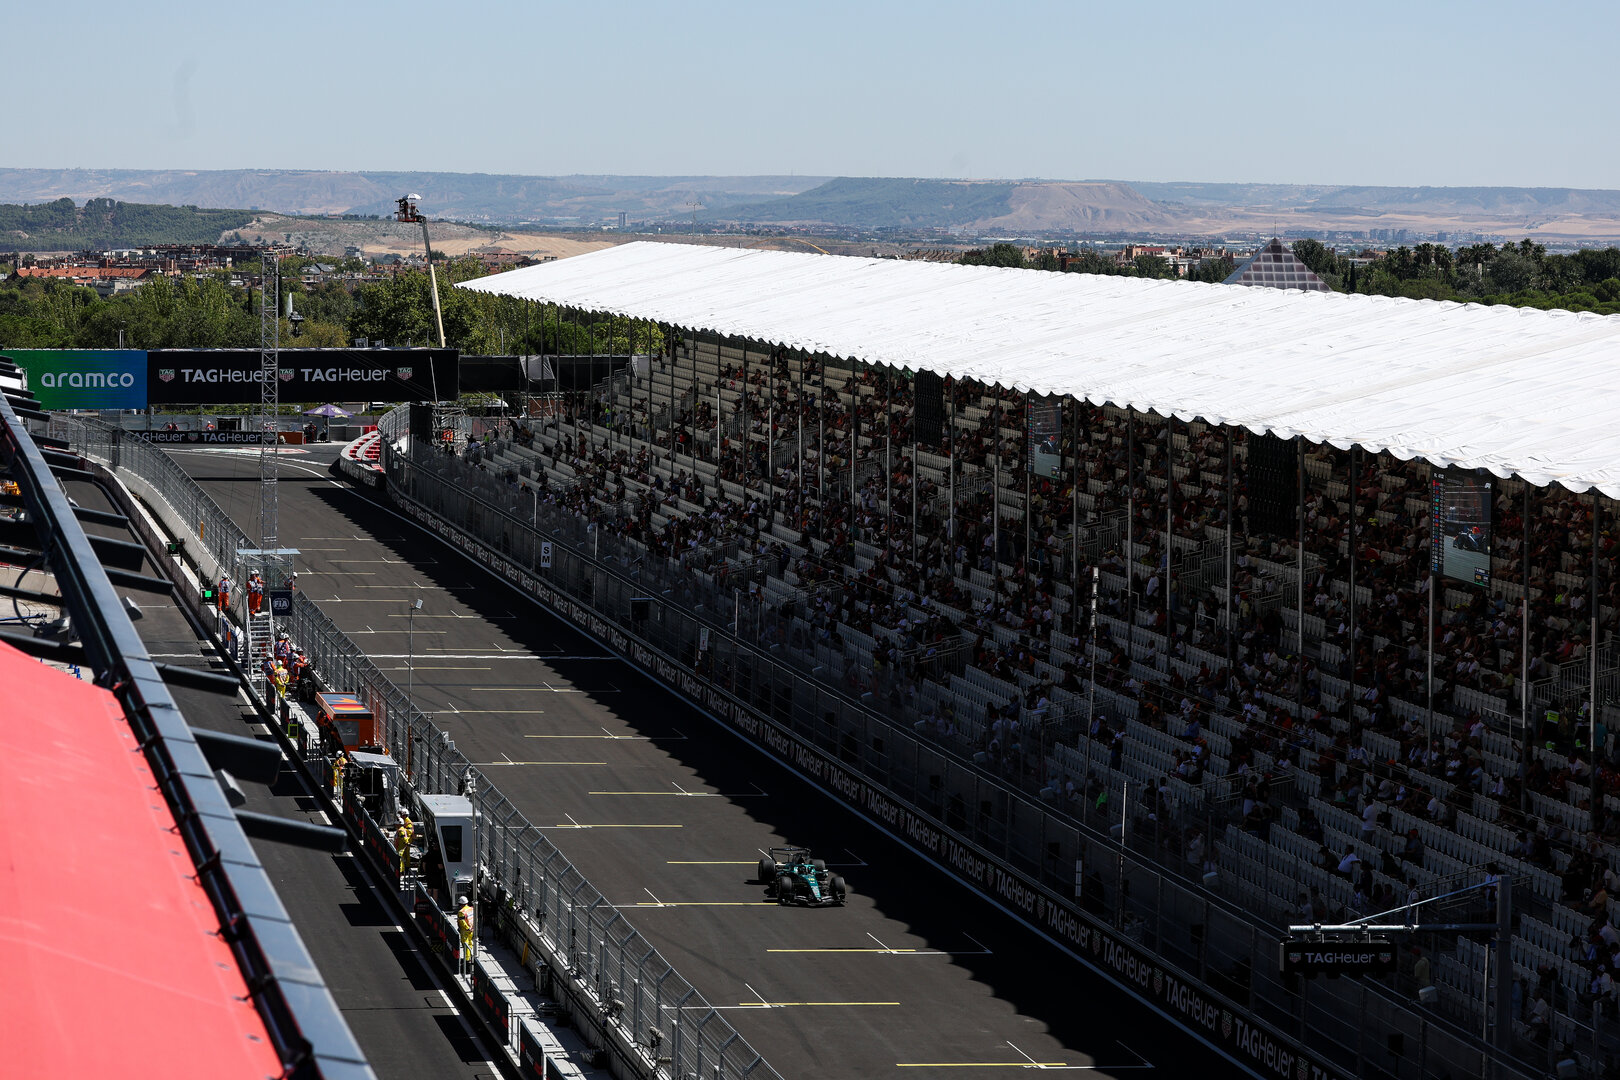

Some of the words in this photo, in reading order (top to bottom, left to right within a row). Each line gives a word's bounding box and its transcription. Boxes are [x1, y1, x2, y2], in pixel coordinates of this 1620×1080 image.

[41, 372, 135, 388] aramco
[301, 368, 391, 382] TAGHeuer
[543, 546, 550, 554] S
[1305, 952, 1376, 963] TAGHeuer
